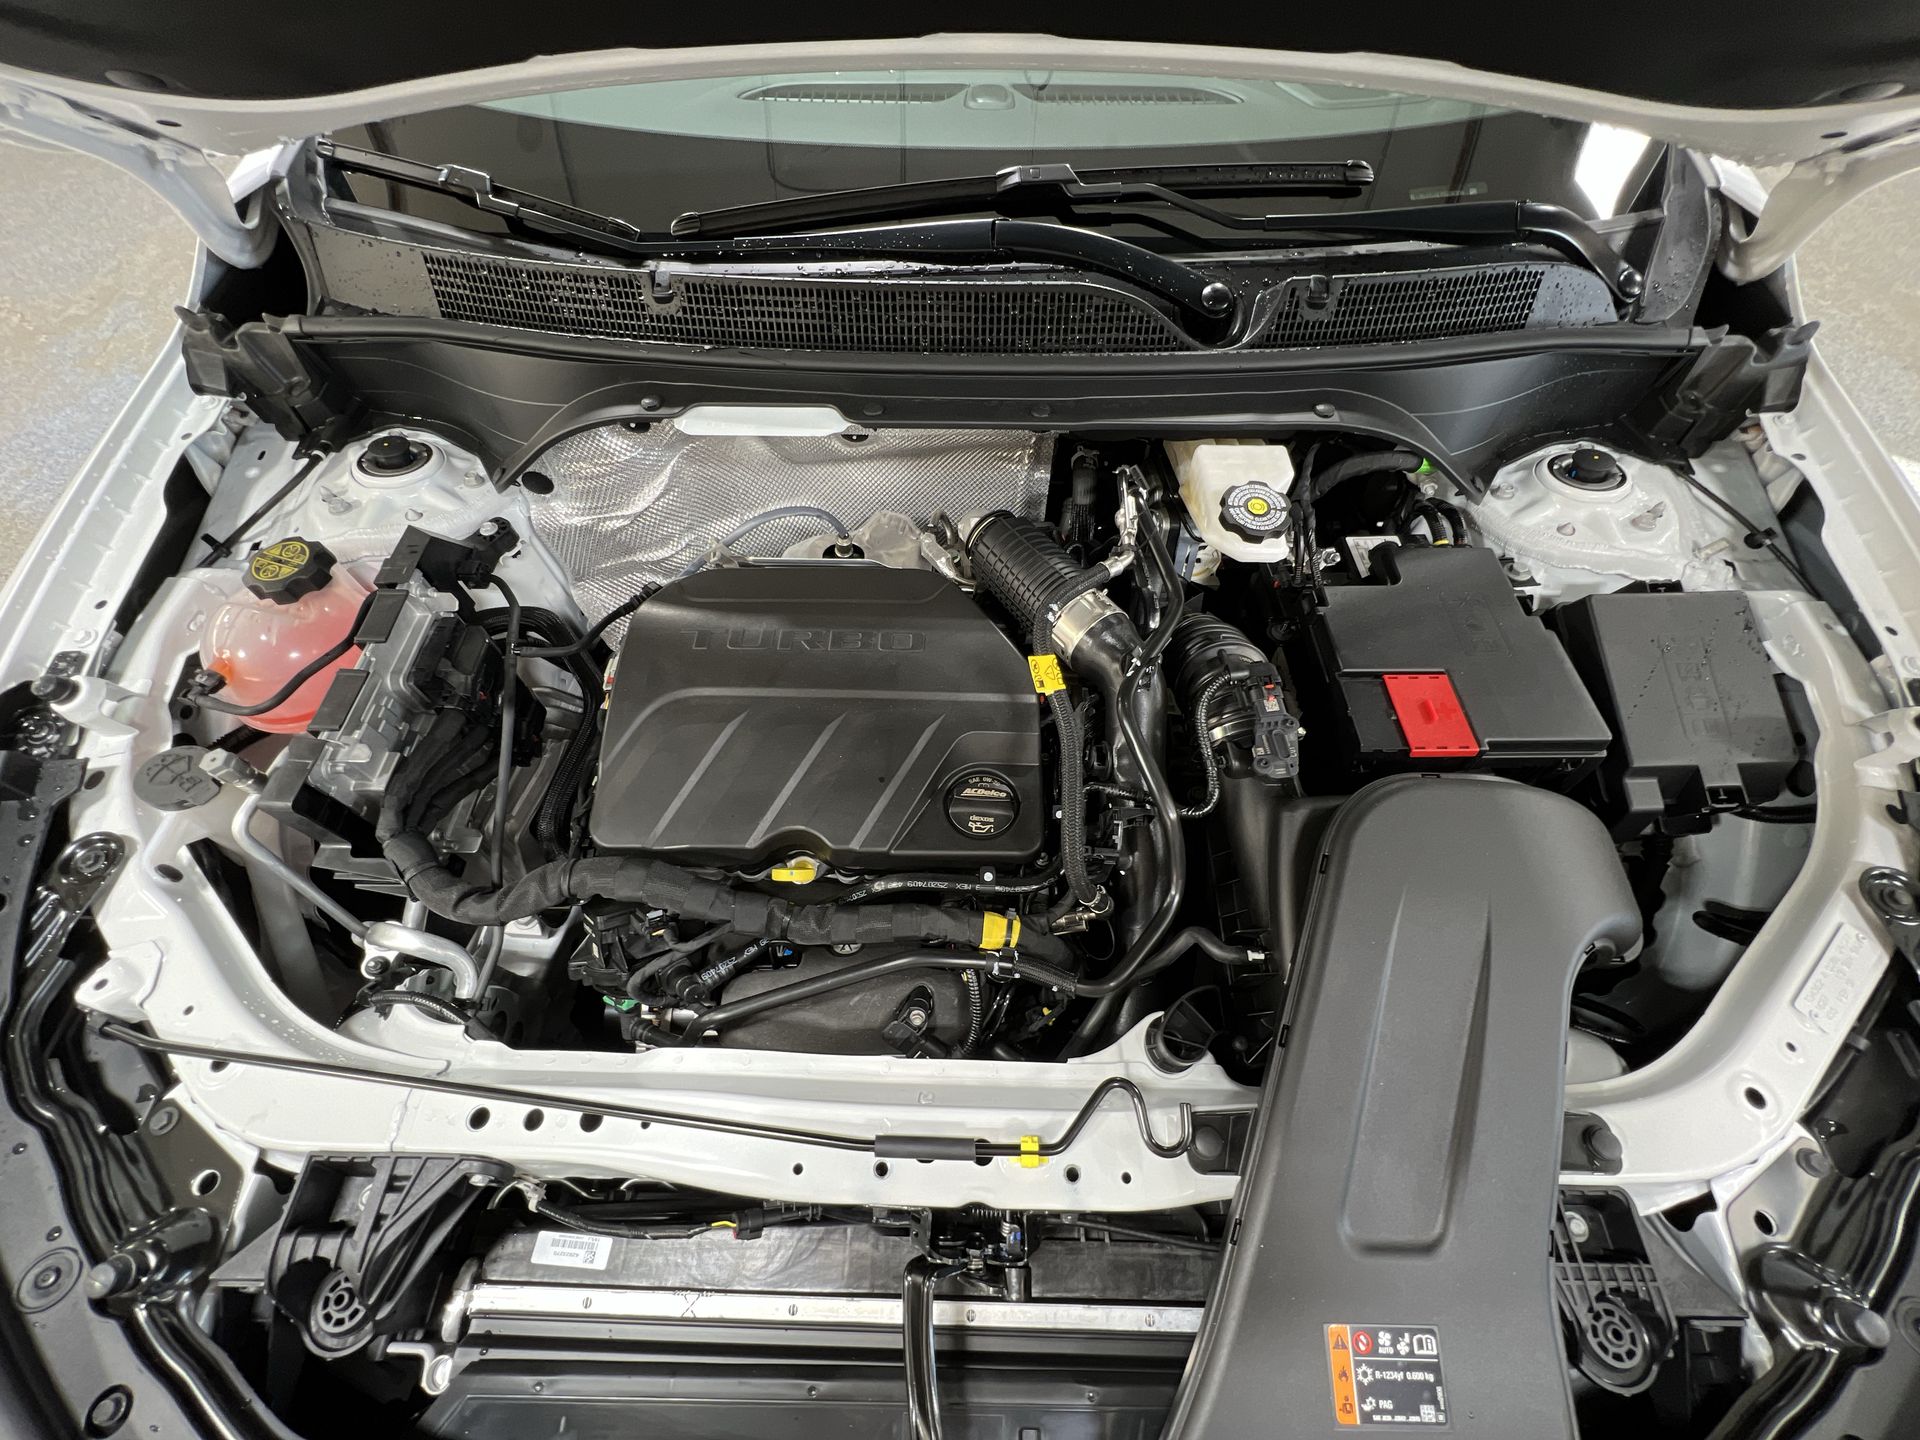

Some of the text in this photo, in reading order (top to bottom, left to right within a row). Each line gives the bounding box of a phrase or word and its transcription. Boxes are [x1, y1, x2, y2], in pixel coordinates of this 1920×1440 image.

[679, 627, 926, 652] TURBO
[961, 787, 1007, 797] ACDelco
[969, 814, 995, 822] dexos
[907, 880, 948, 889] 25207409
[1378, 1346, 1394, 1355] AUTO
[1375, 1370, 1404, 1382] R-1234yf
[1425, 1372, 1435, 1383] kg
[1378, 1400, 1393, 1410] PAG
